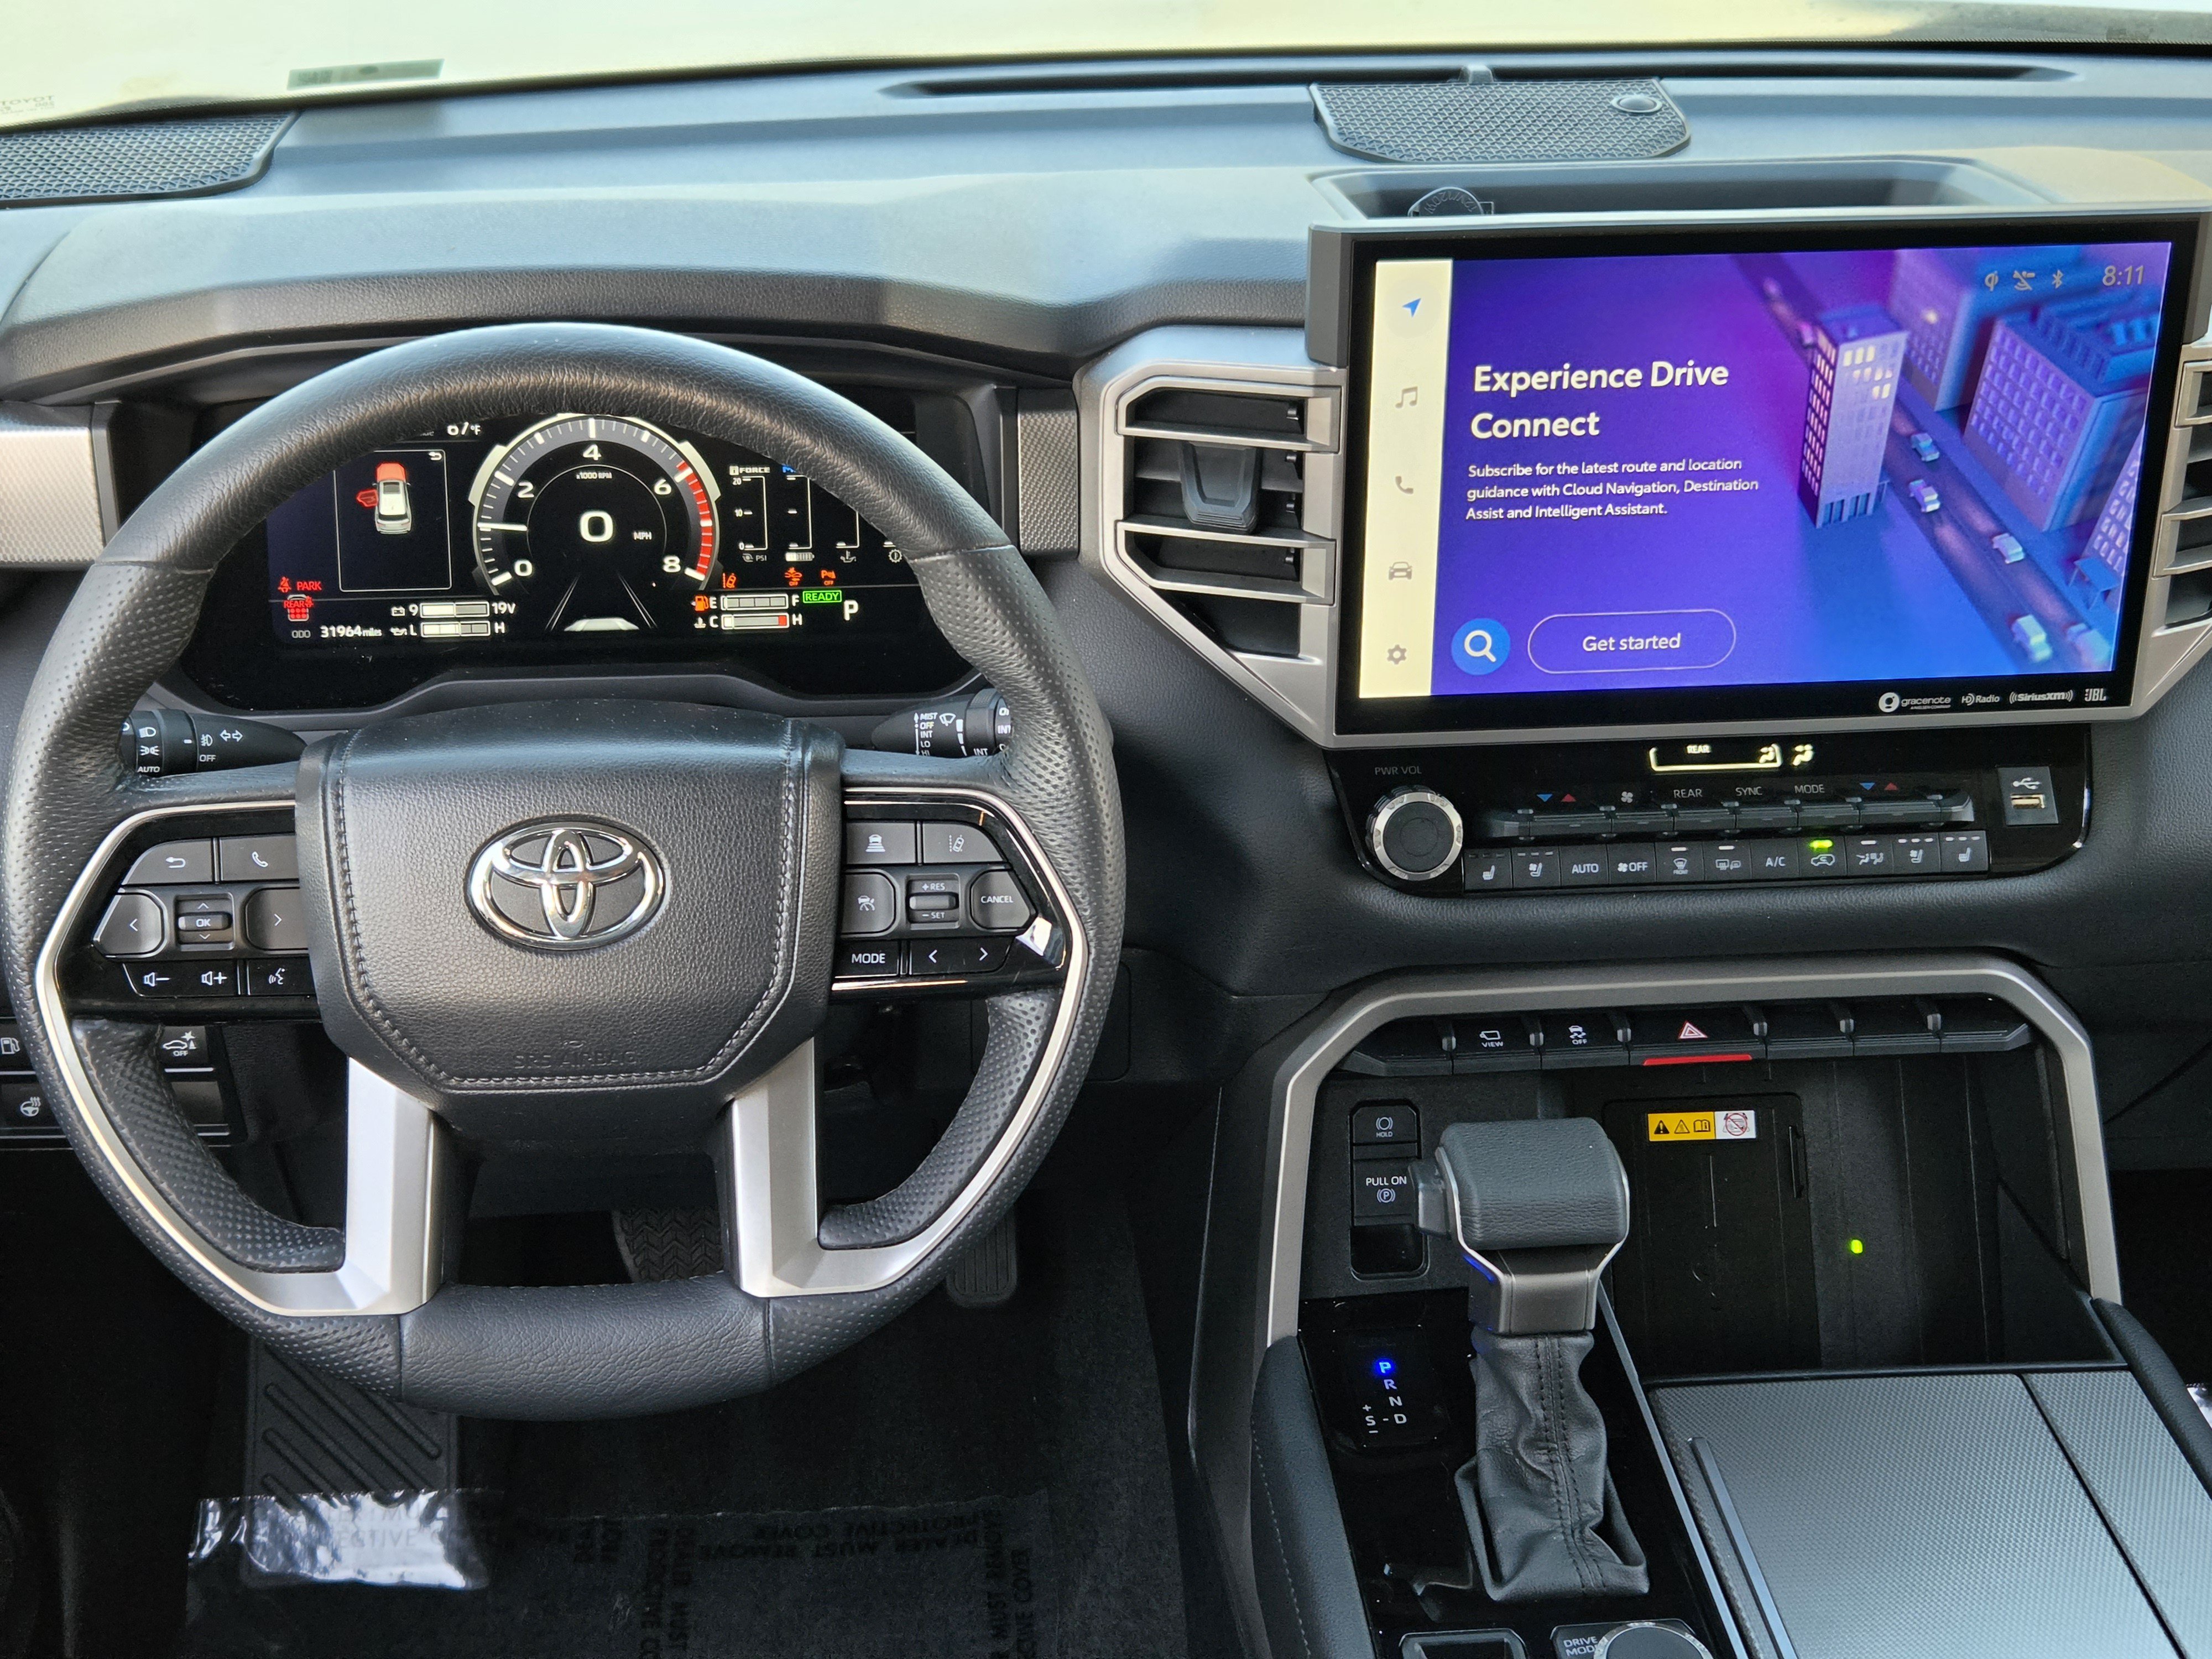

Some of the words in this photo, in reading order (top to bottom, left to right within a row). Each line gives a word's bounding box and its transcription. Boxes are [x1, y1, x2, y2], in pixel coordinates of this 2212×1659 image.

[2103, 265, 2144, 286] 8:11
[1474, 363, 1642, 398] Experience
[1651, 360, 1729, 387] Drive
[1471, 412, 1600, 439] Connect
[583, 445, 601, 460] 4
[1468, 464, 1533, 477] Subscribe
[1536, 463, 1554, 476] for
[1557, 462, 1579, 474] the
[1582, 461, 1619, 474] latest
[1621, 462, 1657, 473] route
[1660, 460, 1685, 472] and
[1688, 458, 1742, 472] location
[518, 482, 534, 498] 2
[654, 479, 672, 495] 6
[1467, 485, 1529, 501] guidance
[1531, 484, 1560, 497] with
[1562, 483, 1603, 496] Cloud
[1606, 482, 1681, 497] Navigation,
[1684, 479, 1759, 493] Destination
[734, 509, 743, 517] 10
[1465, 507, 1504, 520] Assist
[1506, 505, 1532, 518] and
[1535, 505, 1603, 520] Intelligent
[1604, 503, 1668, 517] Assistant.
[580, 511, 613, 542] 0
[514, 560, 533, 576] 0
[663, 556, 681, 572] 8
[296, 581, 322, 591] PARK
[792, 595, 799, 606] F
[805, 592, 839, 601] READY
[284, 600, 304, 608] REAR
[492, 602, 515, 614] 19V
[709, 598, 717, 609] E
[409, 604, 418, 615] 9
[843, 600, 858, 621] P
[709, 616, 718, 628] C
[792, 614, 802, 625] H
[410, 625, 417, 636] L
[494, 623, 505, 633] H
[291, 630, 311, 638] ODO
[1582, 635, 1616, 652] Get
[1619, 633, 1682, 651] started
[1976, 695, 2000, 703] Radio
[2085, 688, 2106, 701] JBL
[1901, 696, 1952, 707] gracenote
[920, 712, 938, 721] MIST
[920, 722, 935, 730] OFF
[920, 731, 933, 739] INT
[974, 748, 988, 757] INT
[1687, 745, 1710, 754] REAR
[1375, 766, 1398, 775] PWR
[1401, 765, 1422, 775] VOL
[1673, 789, 1703, 798] REAR
[1735, 786, 1763, 796] SYNC
[1794, 784, 1825, 794] MODE
[1629, 862, 1648, 872] OFF
[1766, 857, 1786, 867] A/C
[1572, 863, 1599, 874] AUTO
[196, 919, 211, 927] OK
[852, 953, 886, 964] MODE
[1366, 1177, 1389, 1186] PULL
[1391, 1176, 1407, 1185] ON
[1379, 1362, 1391, 1373] P
[1384, 1379, 1397, 1390] R
[1389, 1396, 1402, 1406] N
[1365, 1416, 1376, 1426] S
[1394, 1414, 1407, 1424] D
[1563, 1636, 1598, 1647] DRIVE
